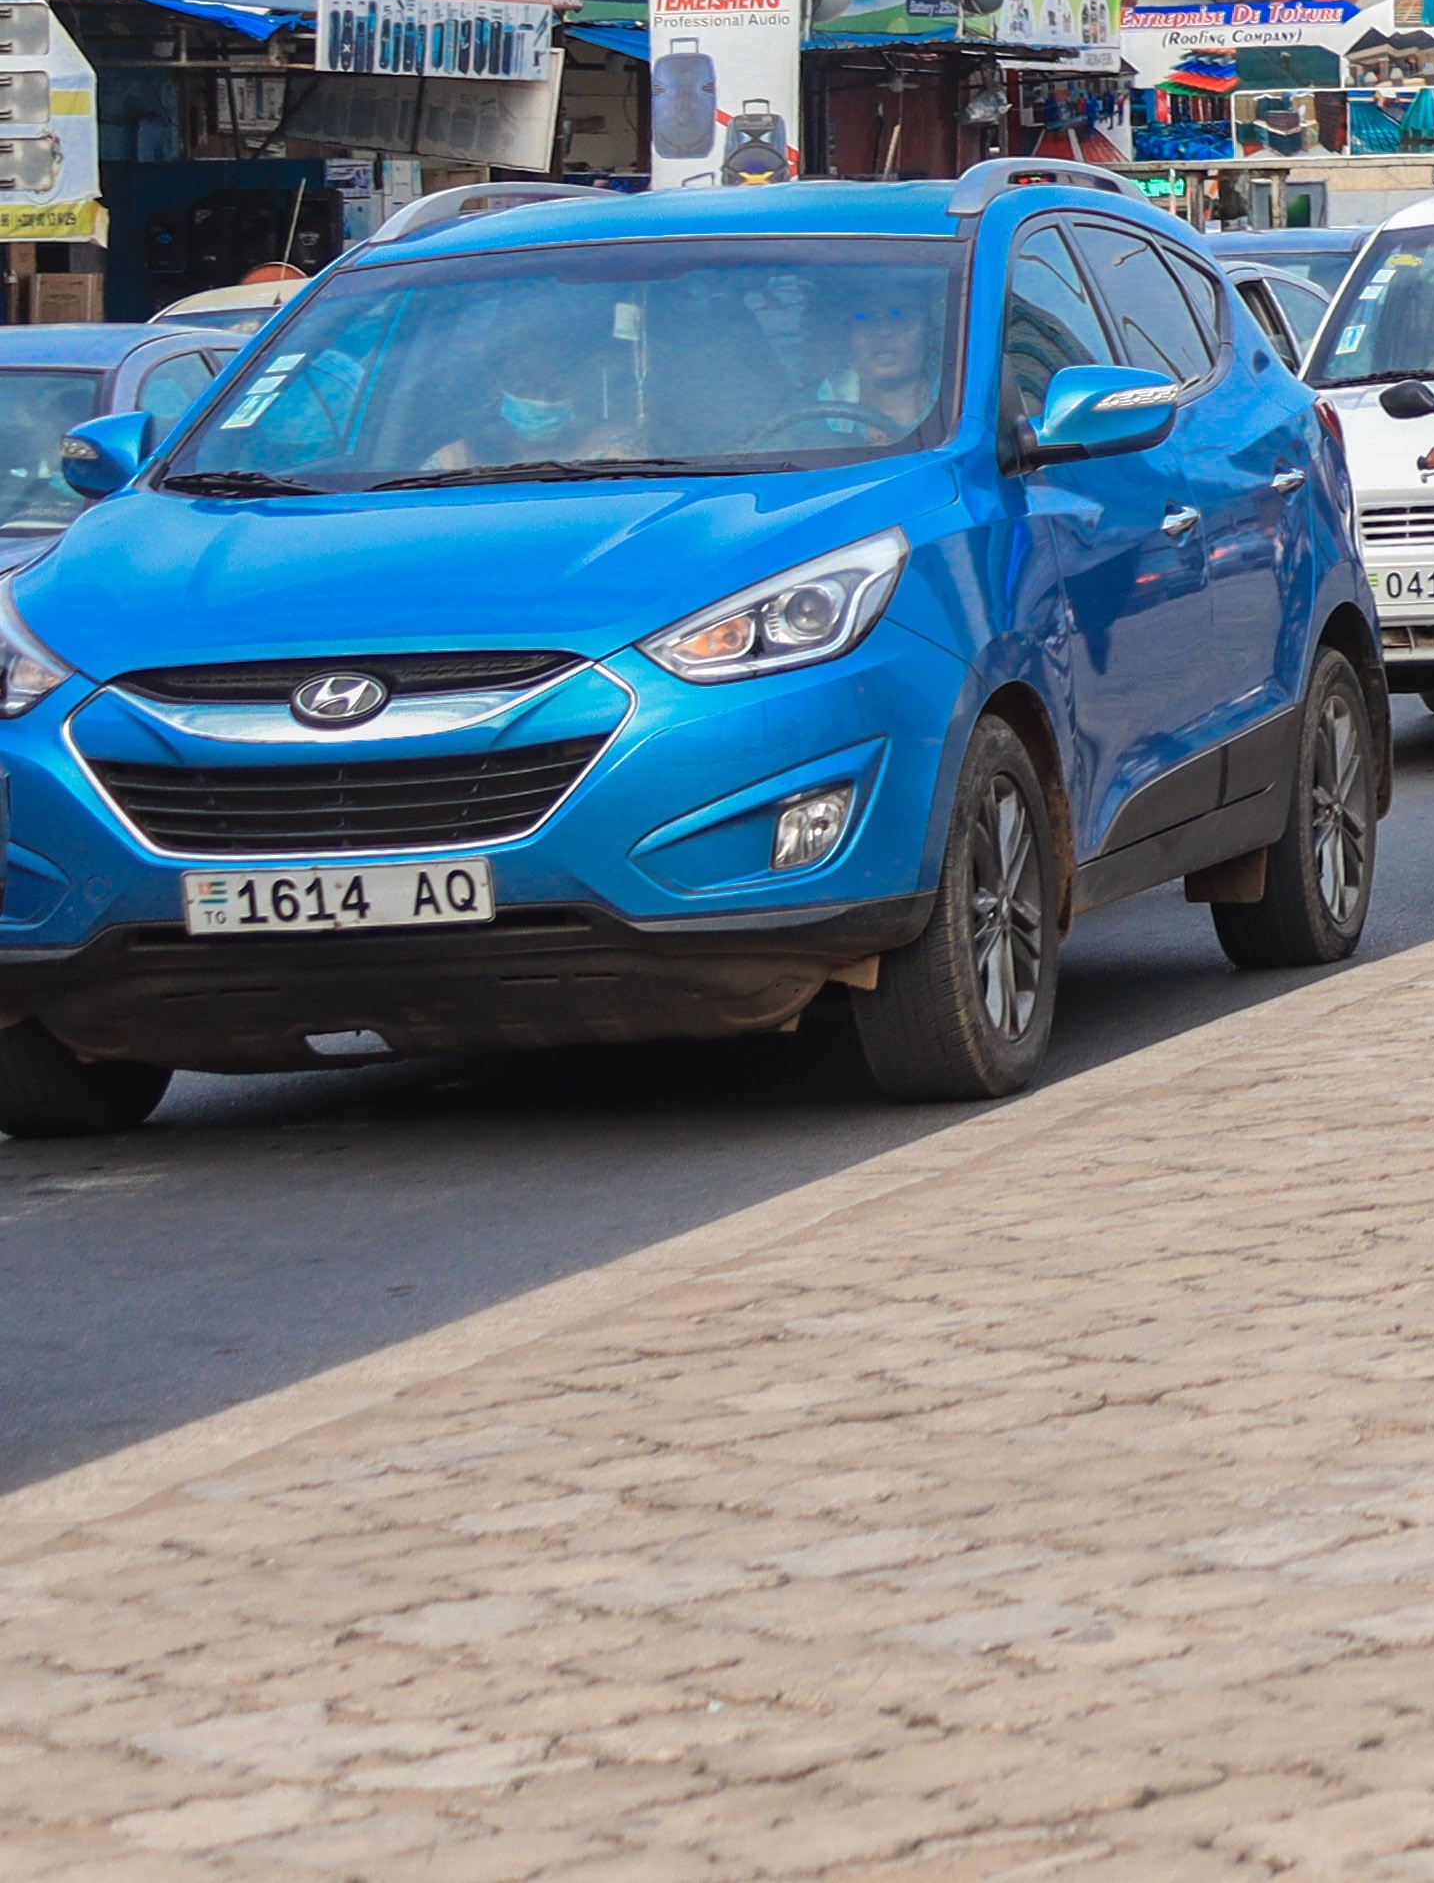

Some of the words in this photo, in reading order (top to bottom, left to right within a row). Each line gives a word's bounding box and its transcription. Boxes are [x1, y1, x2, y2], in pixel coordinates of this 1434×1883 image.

[653, 13, 745, 28] Professional
[748, 12, 791, 28] Audio
[236, 873, 371, 925] 1614
[412, 868, 478, 916] AQ
